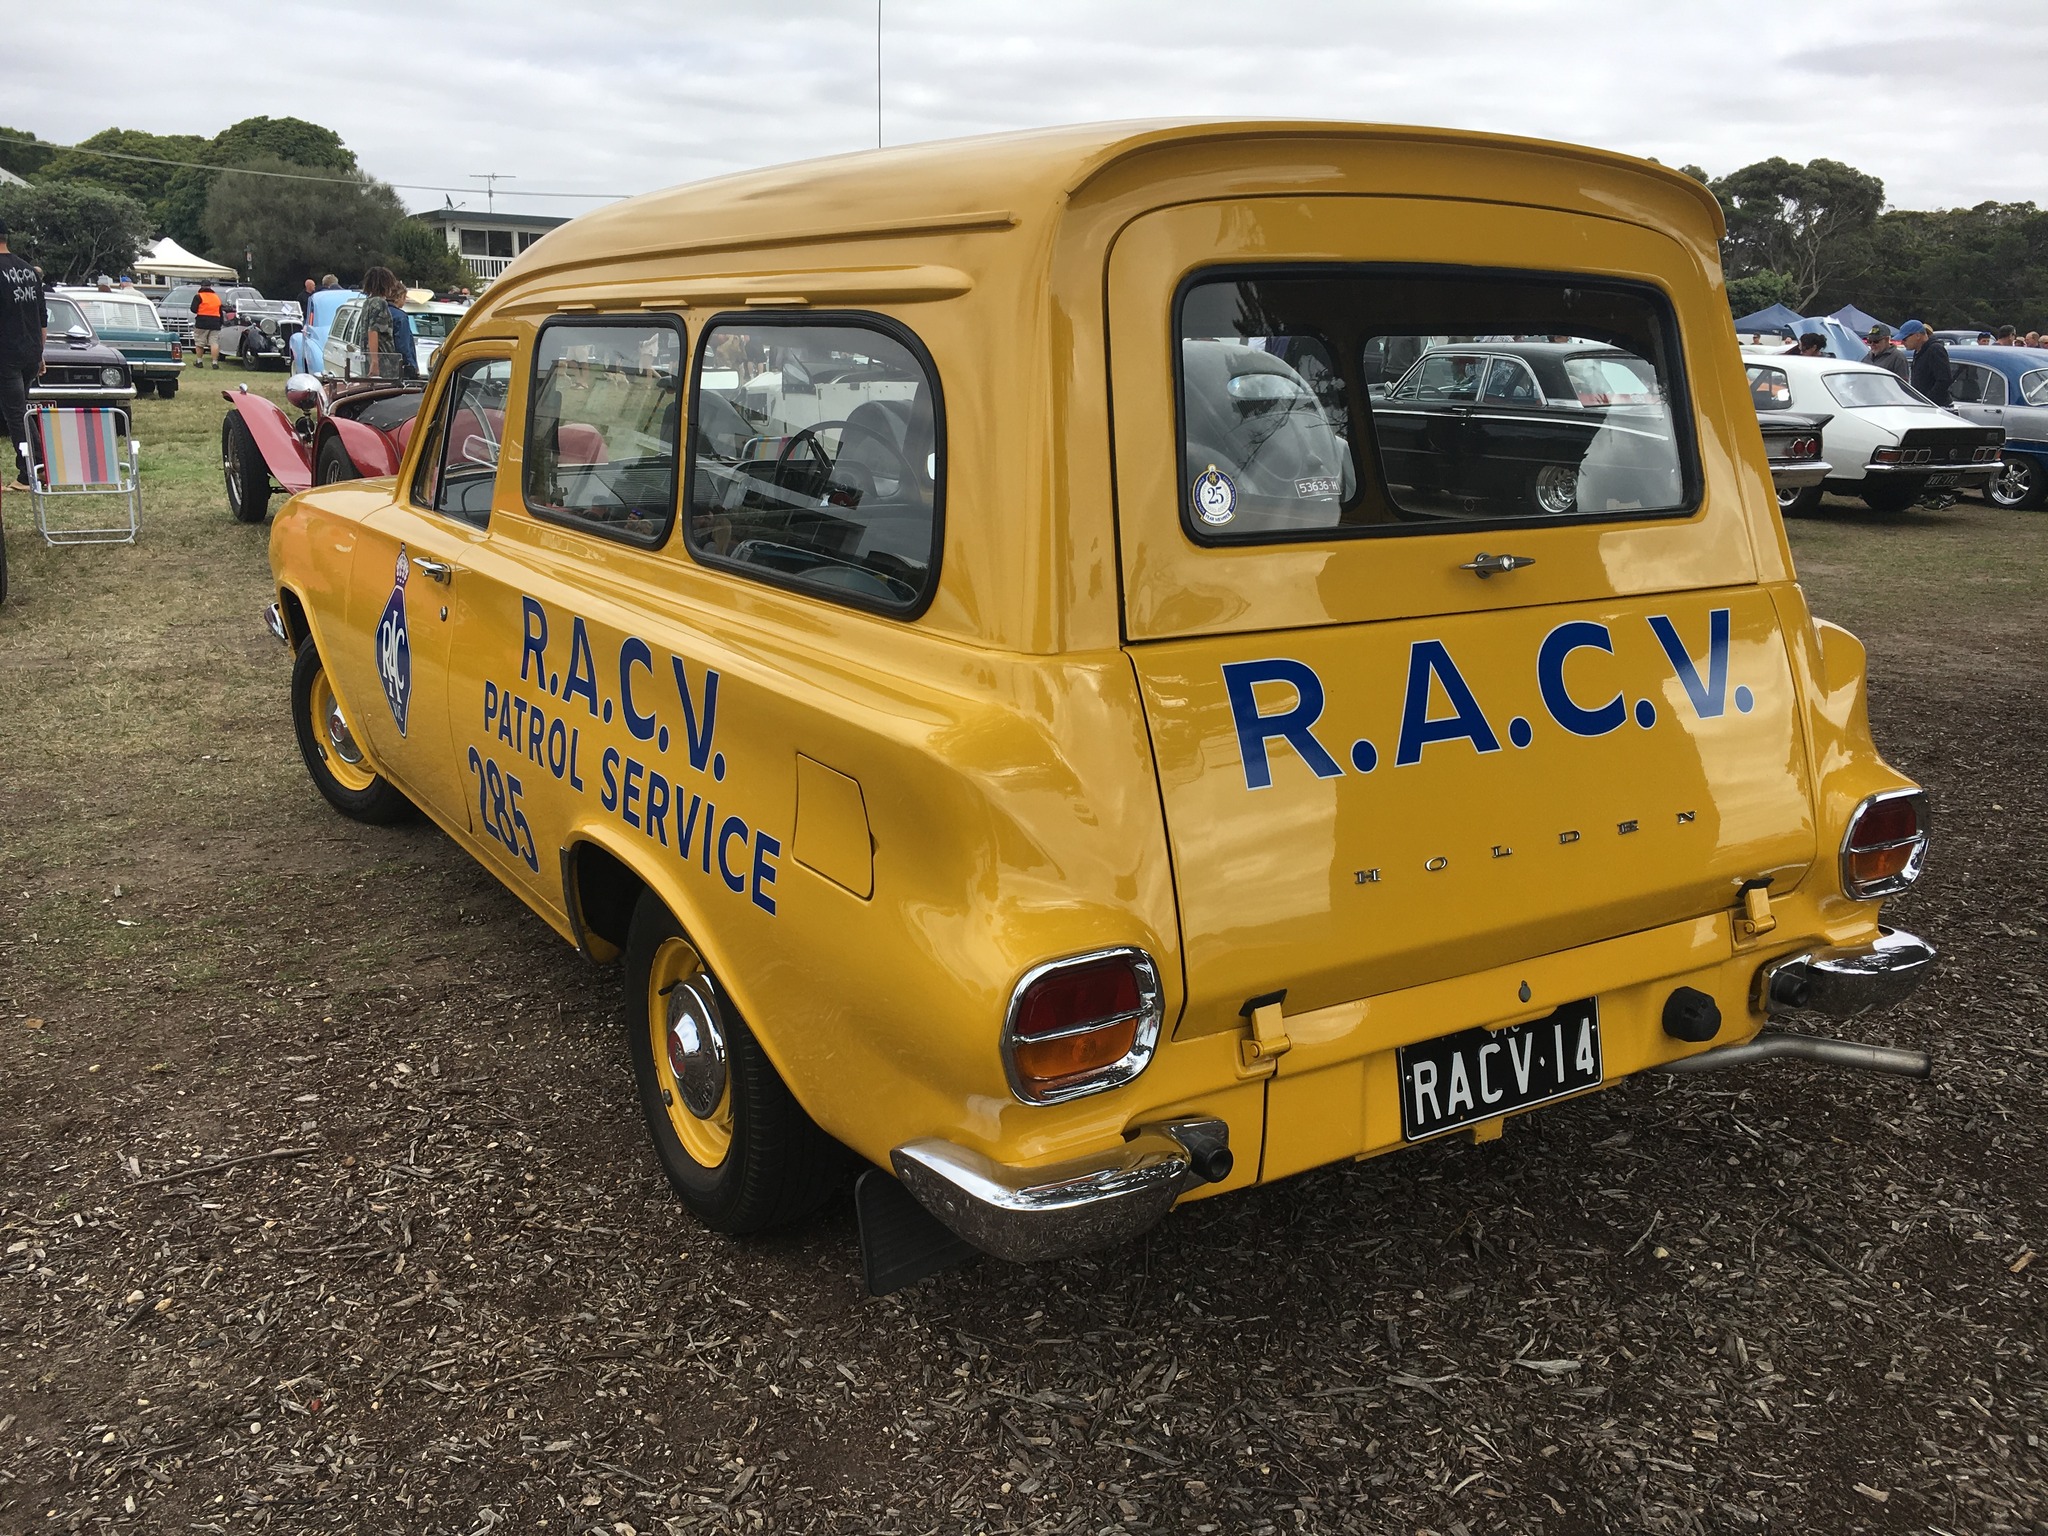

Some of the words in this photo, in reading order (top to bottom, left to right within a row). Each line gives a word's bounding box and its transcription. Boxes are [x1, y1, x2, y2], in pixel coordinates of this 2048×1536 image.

[1207, 486, 1224, 504] 25
[520, 595, 726, 782] R.A.C.V.
[1220, 607, 1755, 791] R.A.C.V.
[467, 745, 540, 875] 285
[484, 680, 584, 793] PATROL
[600, 747, 781, 917] SERVICE
[1353, 809, 1698, 885] HOLDEN
